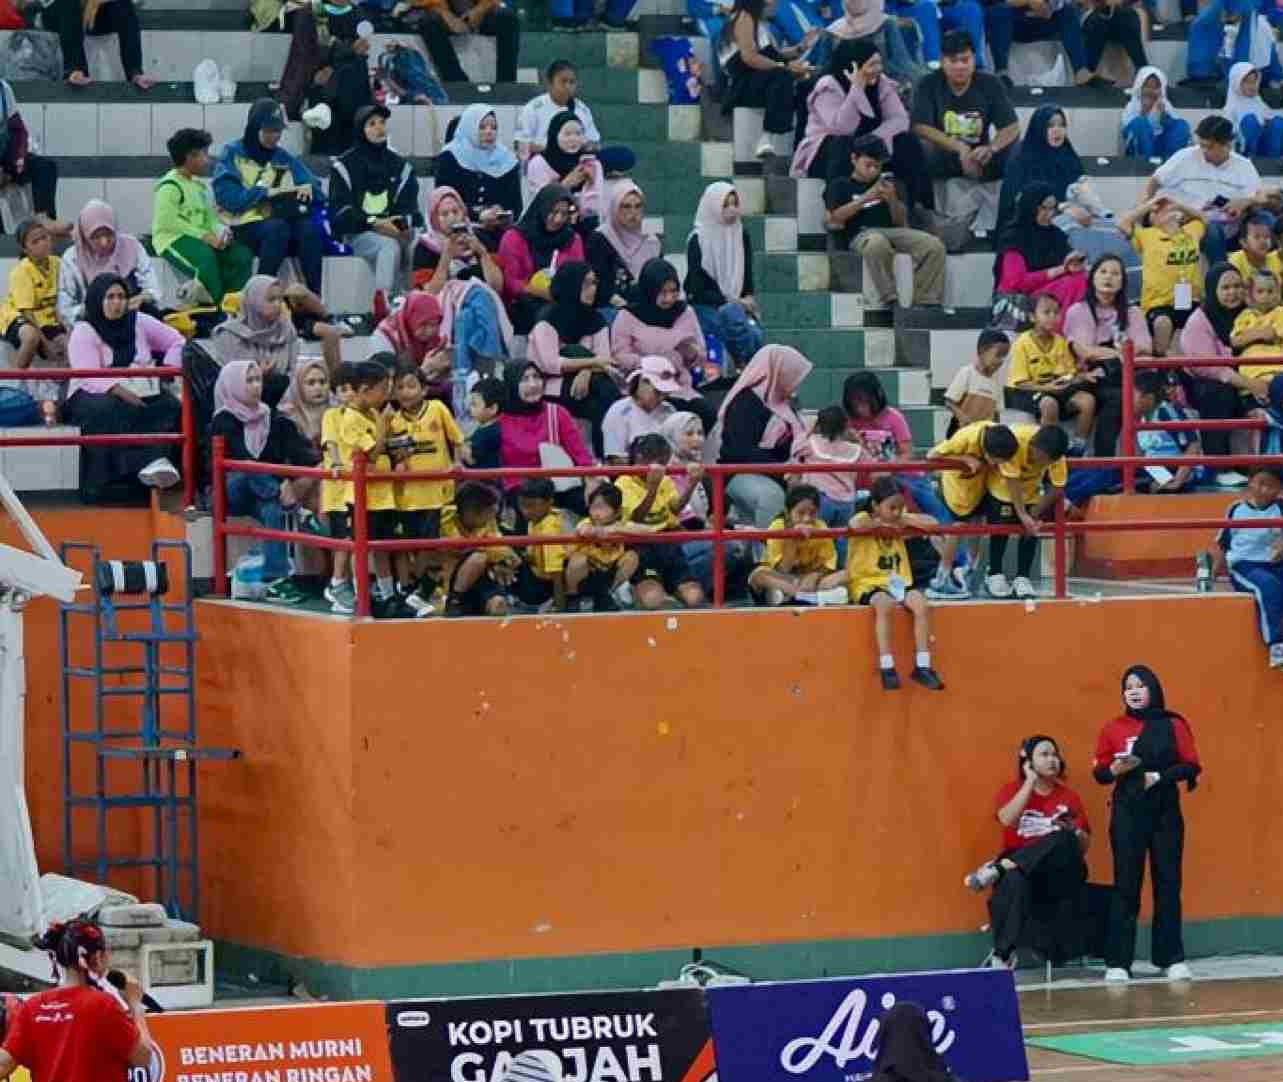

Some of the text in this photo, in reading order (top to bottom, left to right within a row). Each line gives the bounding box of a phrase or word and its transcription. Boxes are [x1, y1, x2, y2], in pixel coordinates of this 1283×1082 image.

[448, 1013, 658, 1046] KOPI TUBRUK
[180, 1038, 362, 1065] BENERAN MURNI
